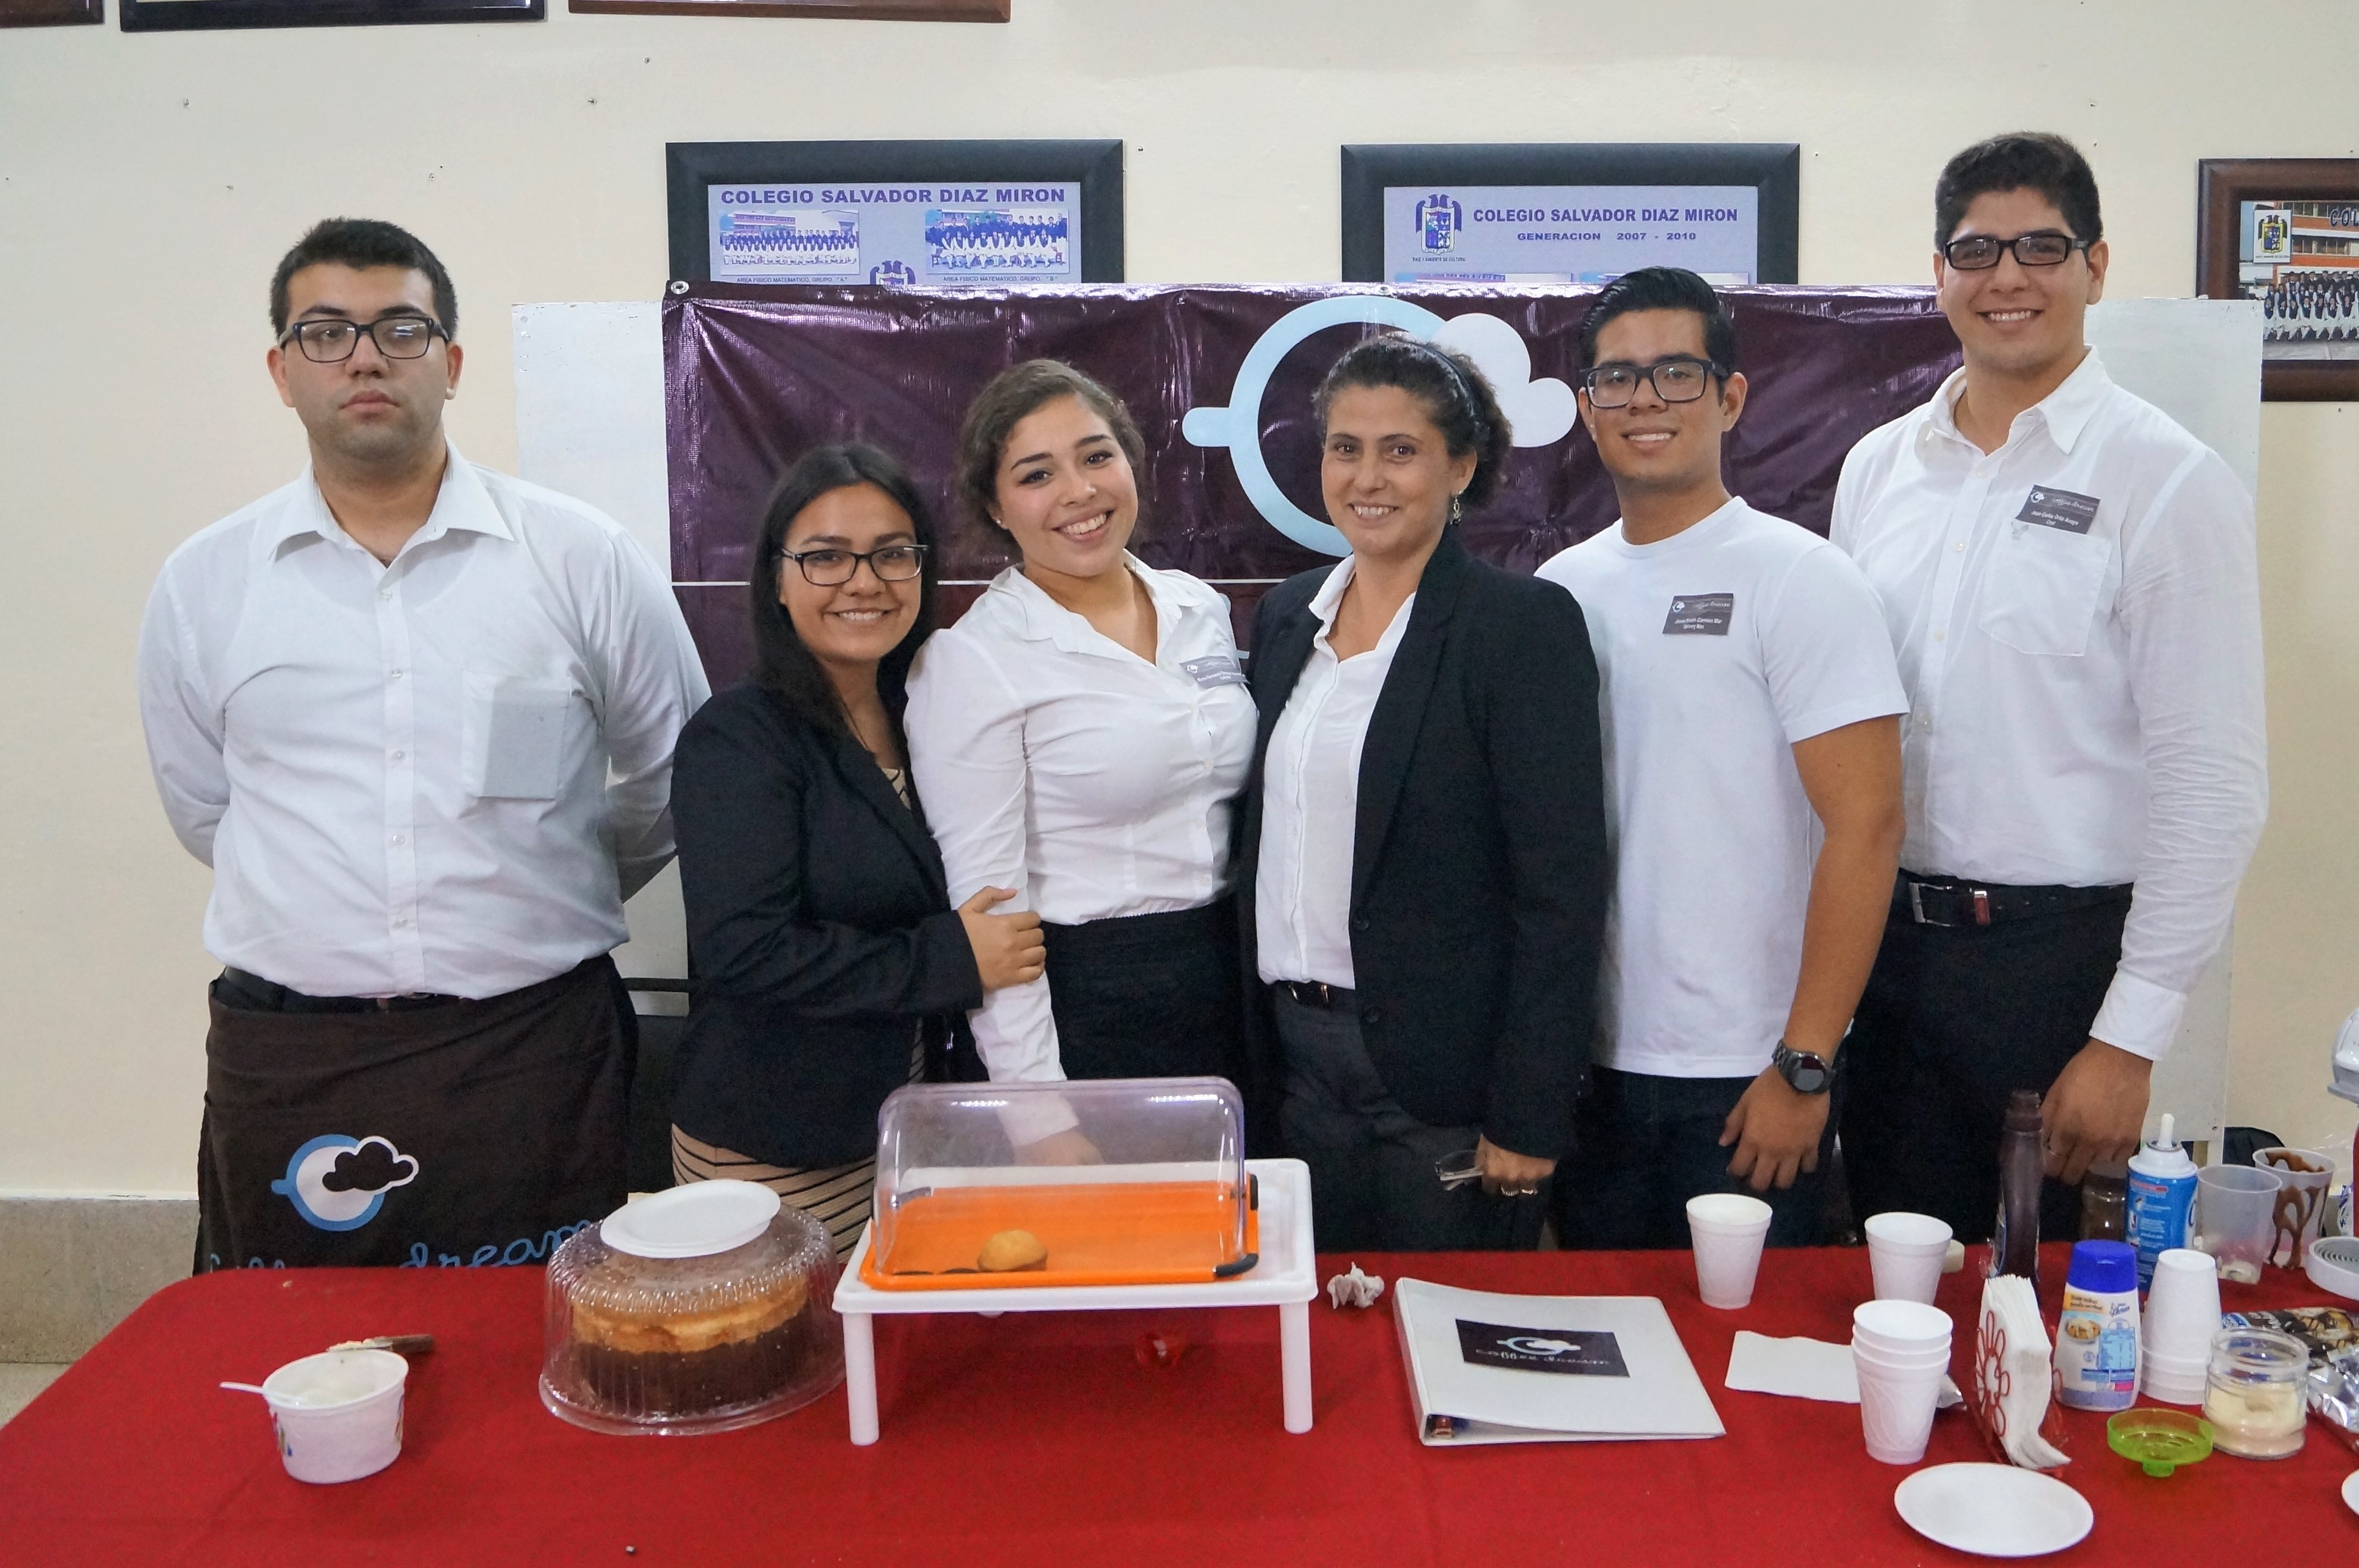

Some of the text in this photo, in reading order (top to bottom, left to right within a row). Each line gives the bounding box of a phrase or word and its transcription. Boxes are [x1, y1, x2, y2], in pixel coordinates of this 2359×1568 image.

[721, 189, 1065, 204] COLEGIO SALVADOR DIAZ MIRON
[1473, 208, 1737, 222] COLEGIO SALVADOR DIAZ MIRON
[1517, 233, 1601, 241] GENERACION
[1617, 233, 1647, 241] 2007
[1666, 232, 1696, 240] 2010
